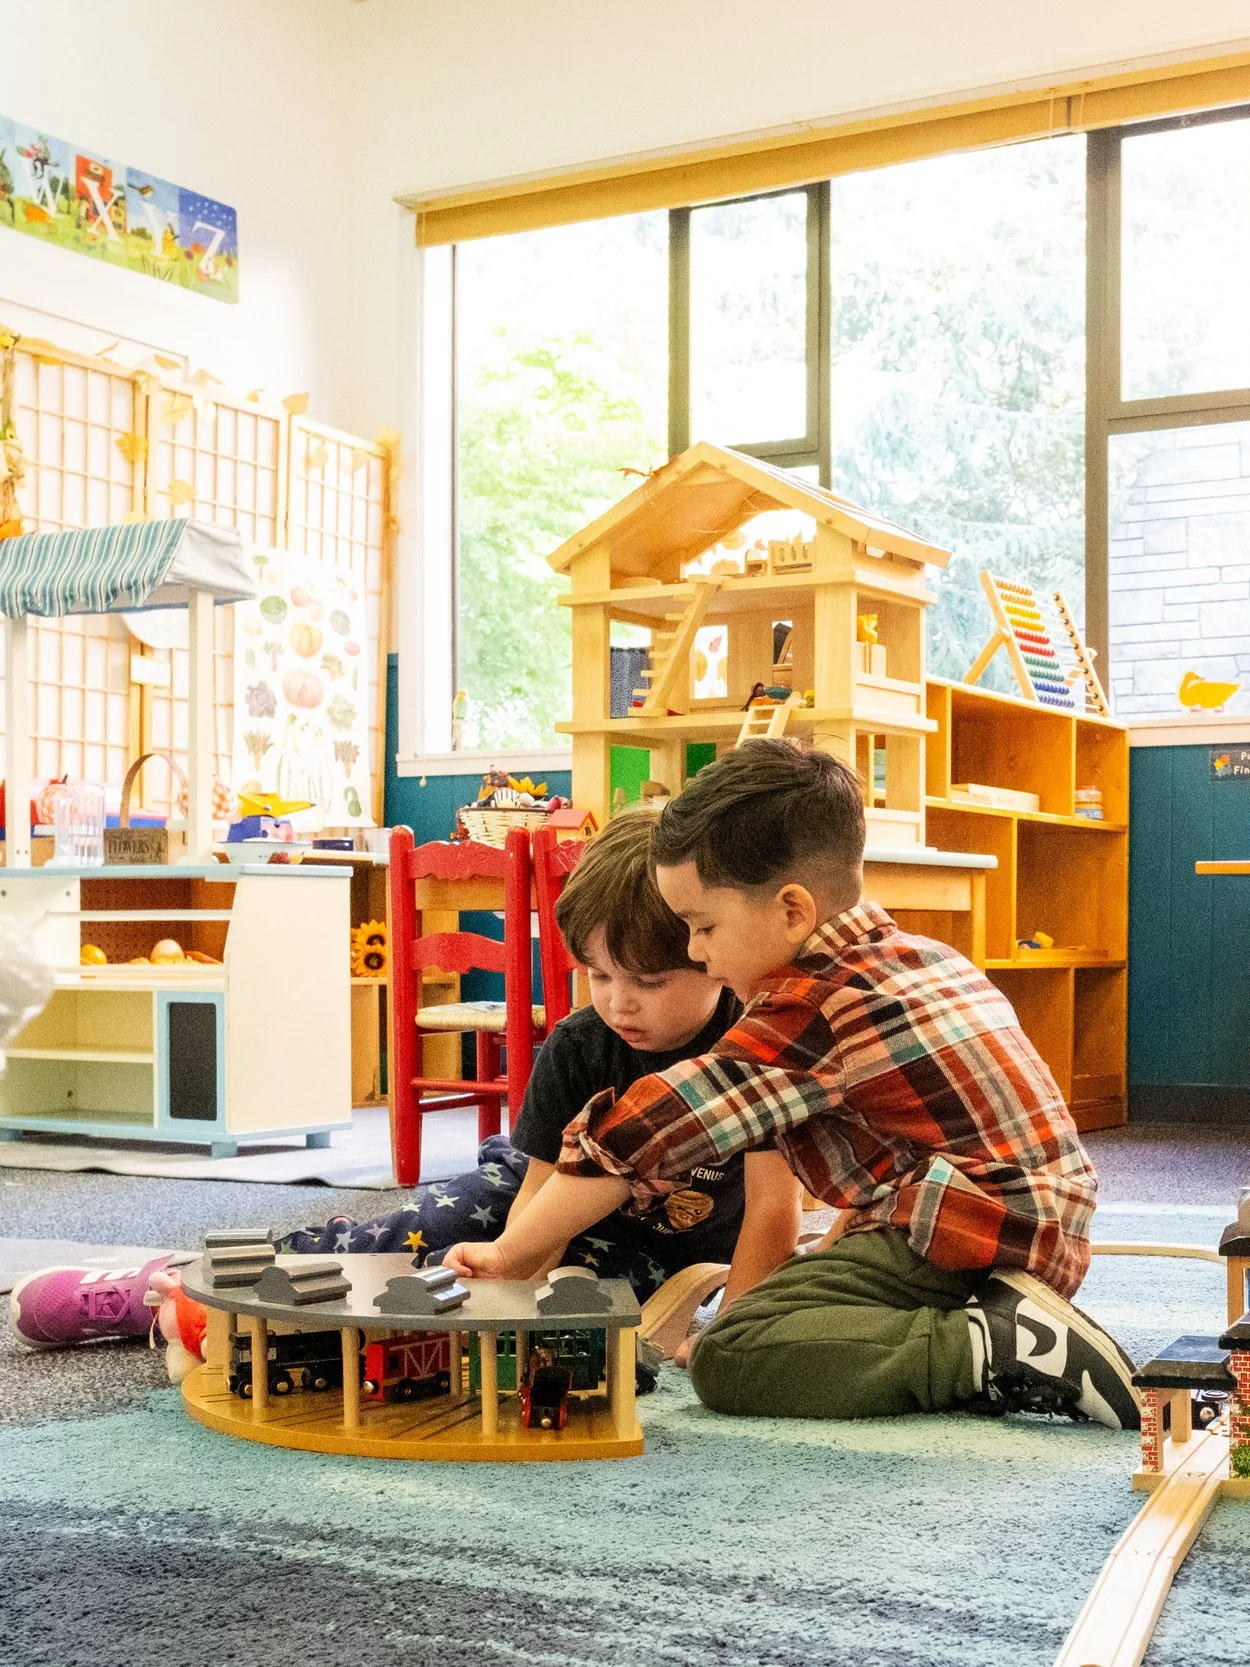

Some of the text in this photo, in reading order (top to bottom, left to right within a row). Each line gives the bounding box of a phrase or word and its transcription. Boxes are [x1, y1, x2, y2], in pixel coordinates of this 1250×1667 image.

[19, 156, 227, 282] W X Y Z
[690, 1167, 725, 1182] VENUS
